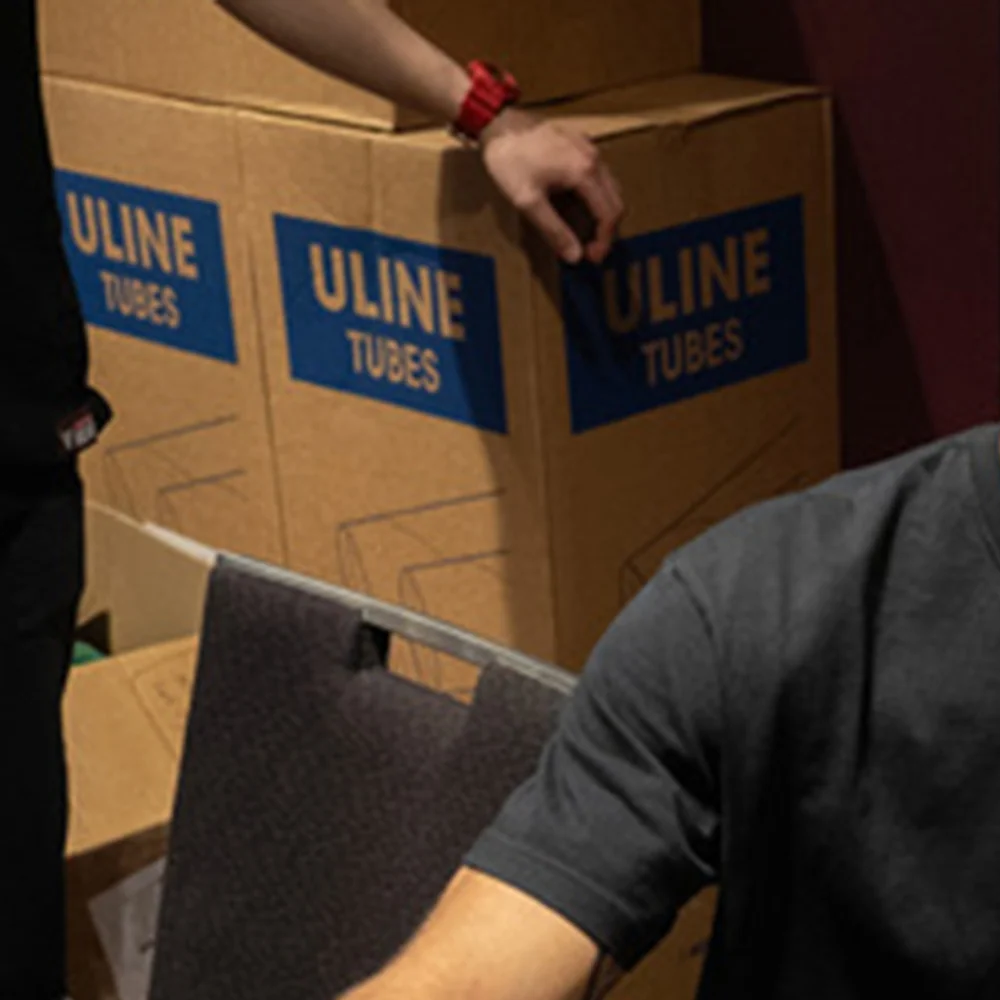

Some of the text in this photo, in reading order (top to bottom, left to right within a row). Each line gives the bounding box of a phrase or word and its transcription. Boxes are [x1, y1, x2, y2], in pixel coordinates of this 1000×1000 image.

[66, 191, 198, 280] ULINE
[100, 270, 181, 329] TUBES
[309, 243, 466, 341] ULINE
[603, 227, 772, 334] ULINE
[345, 328, 442, 394] TUBES
[641, 317, 745, 387] TUBES
